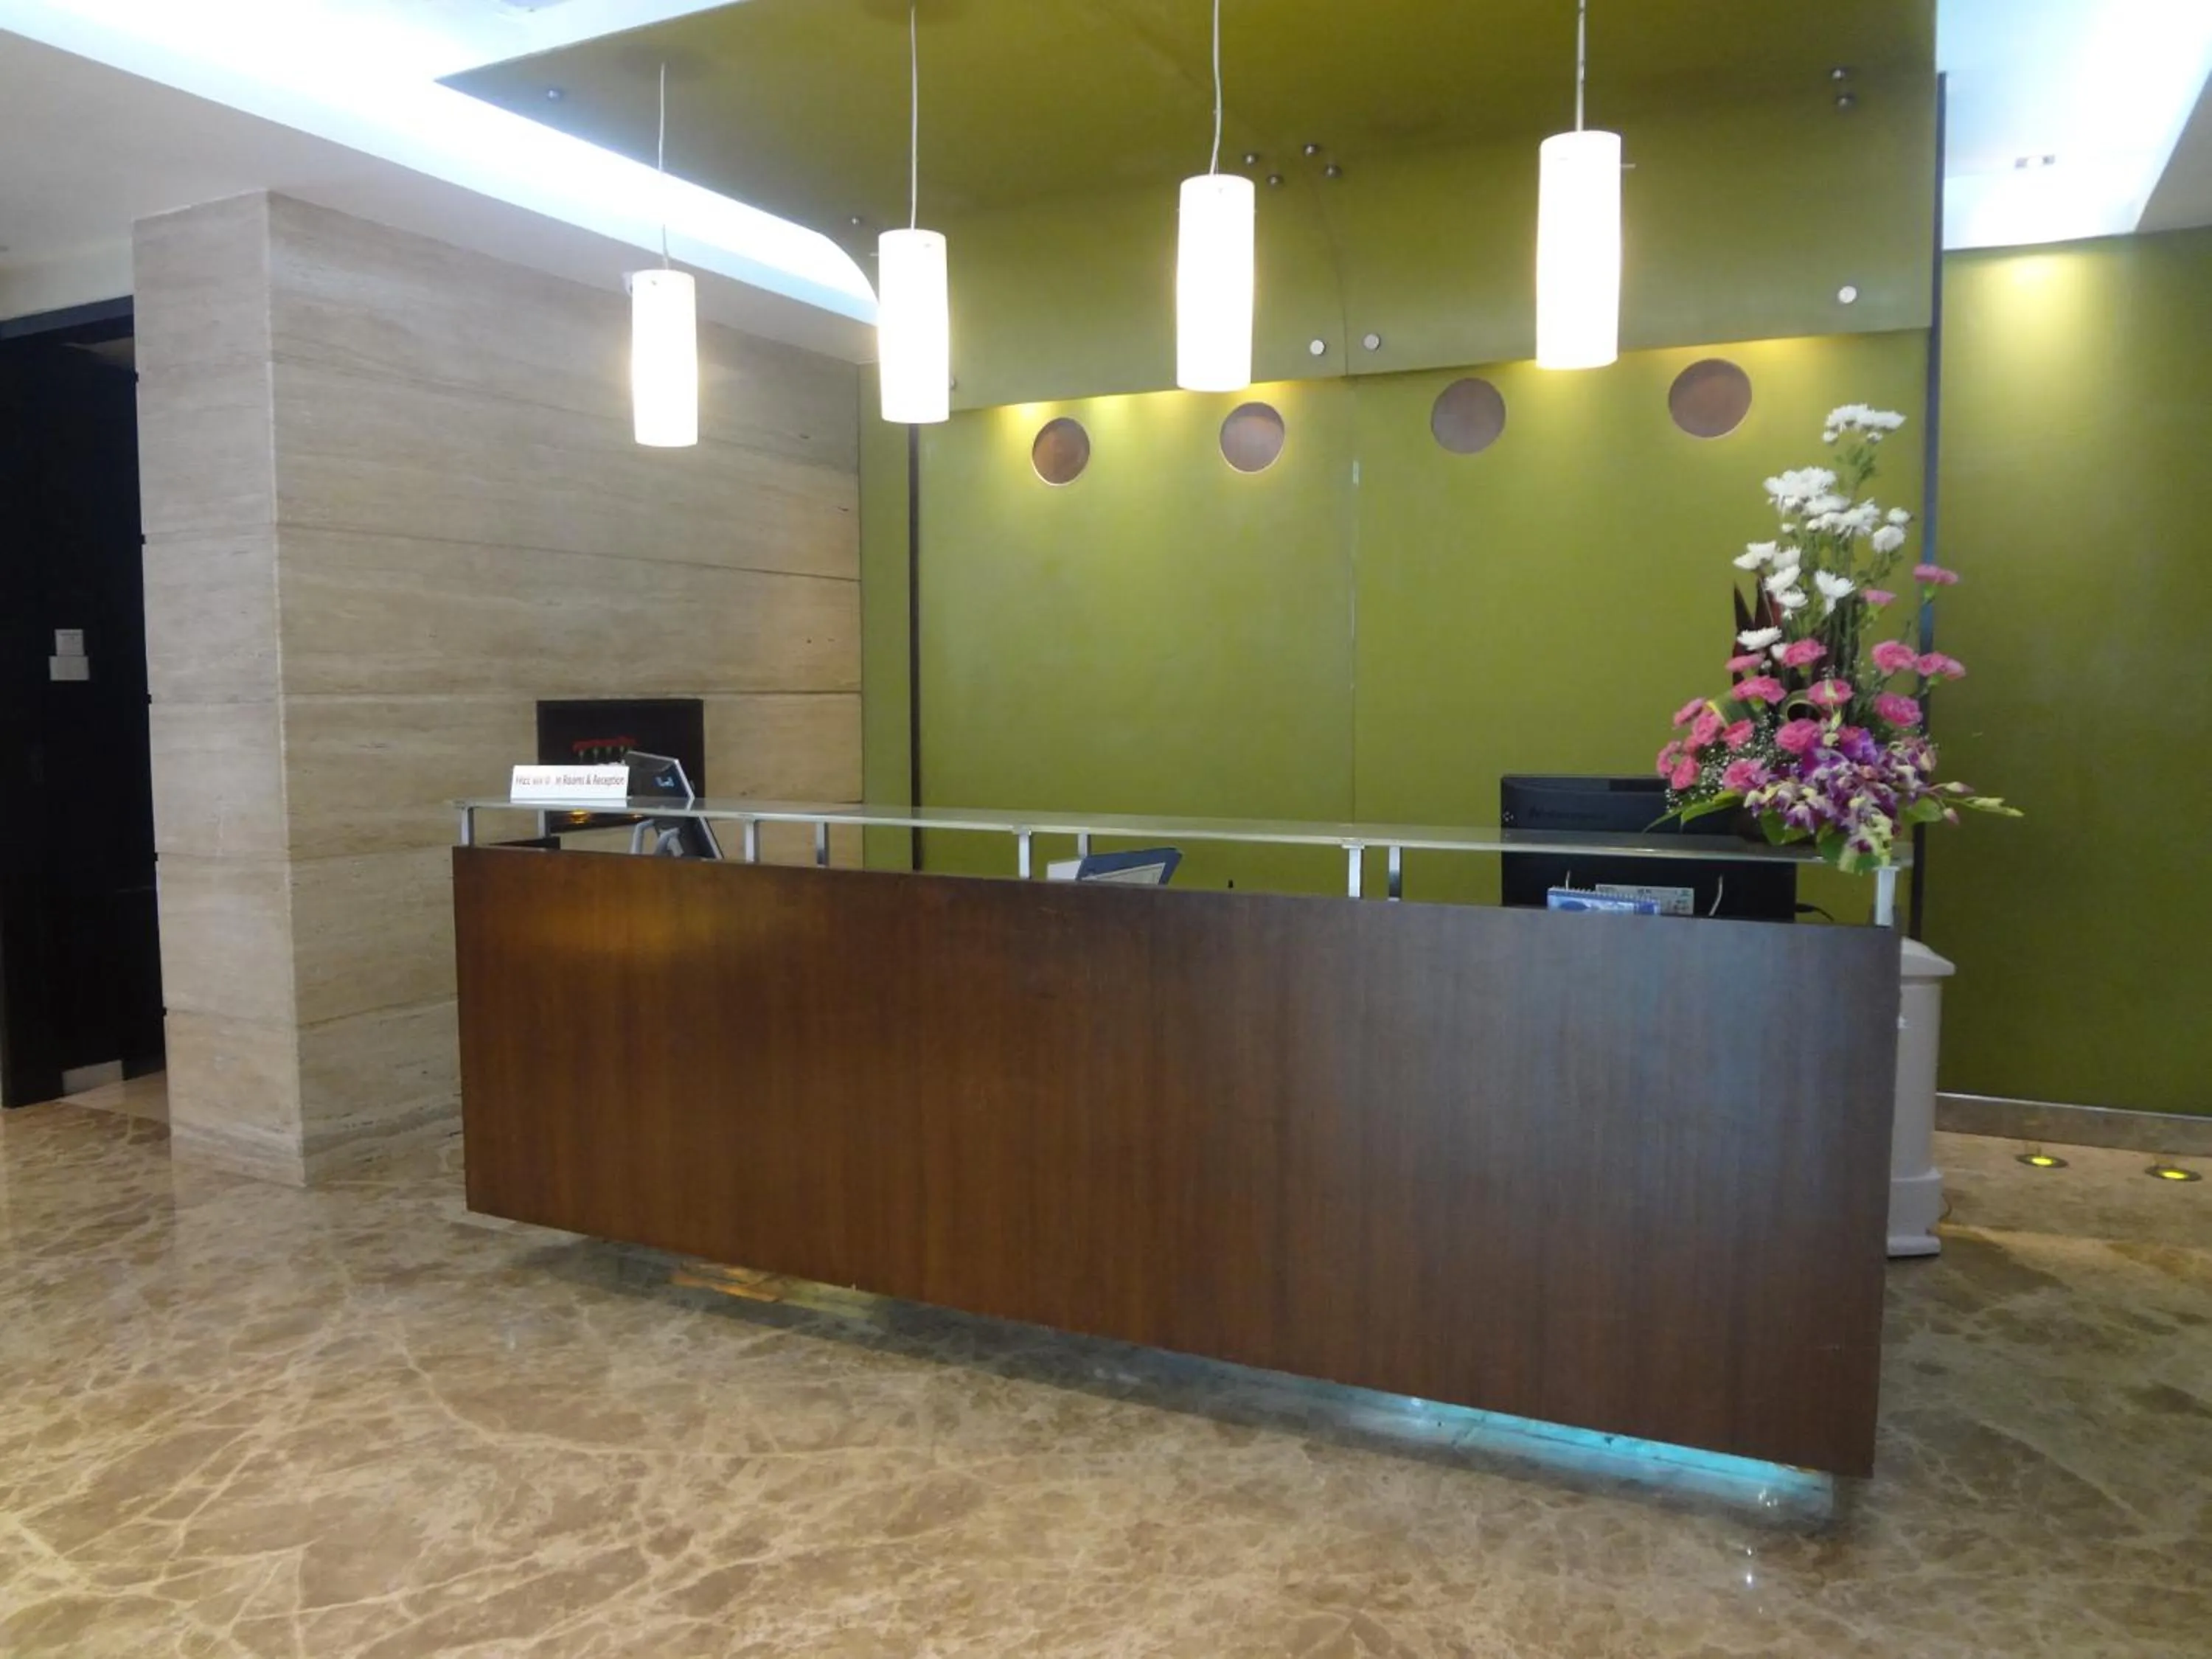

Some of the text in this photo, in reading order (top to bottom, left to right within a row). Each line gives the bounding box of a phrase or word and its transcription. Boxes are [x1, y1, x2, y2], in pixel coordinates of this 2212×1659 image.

[563, 774, 585, 785] Rooms
[585, 774, 591, 785] &
[592, 774, 625, 786] Reception
